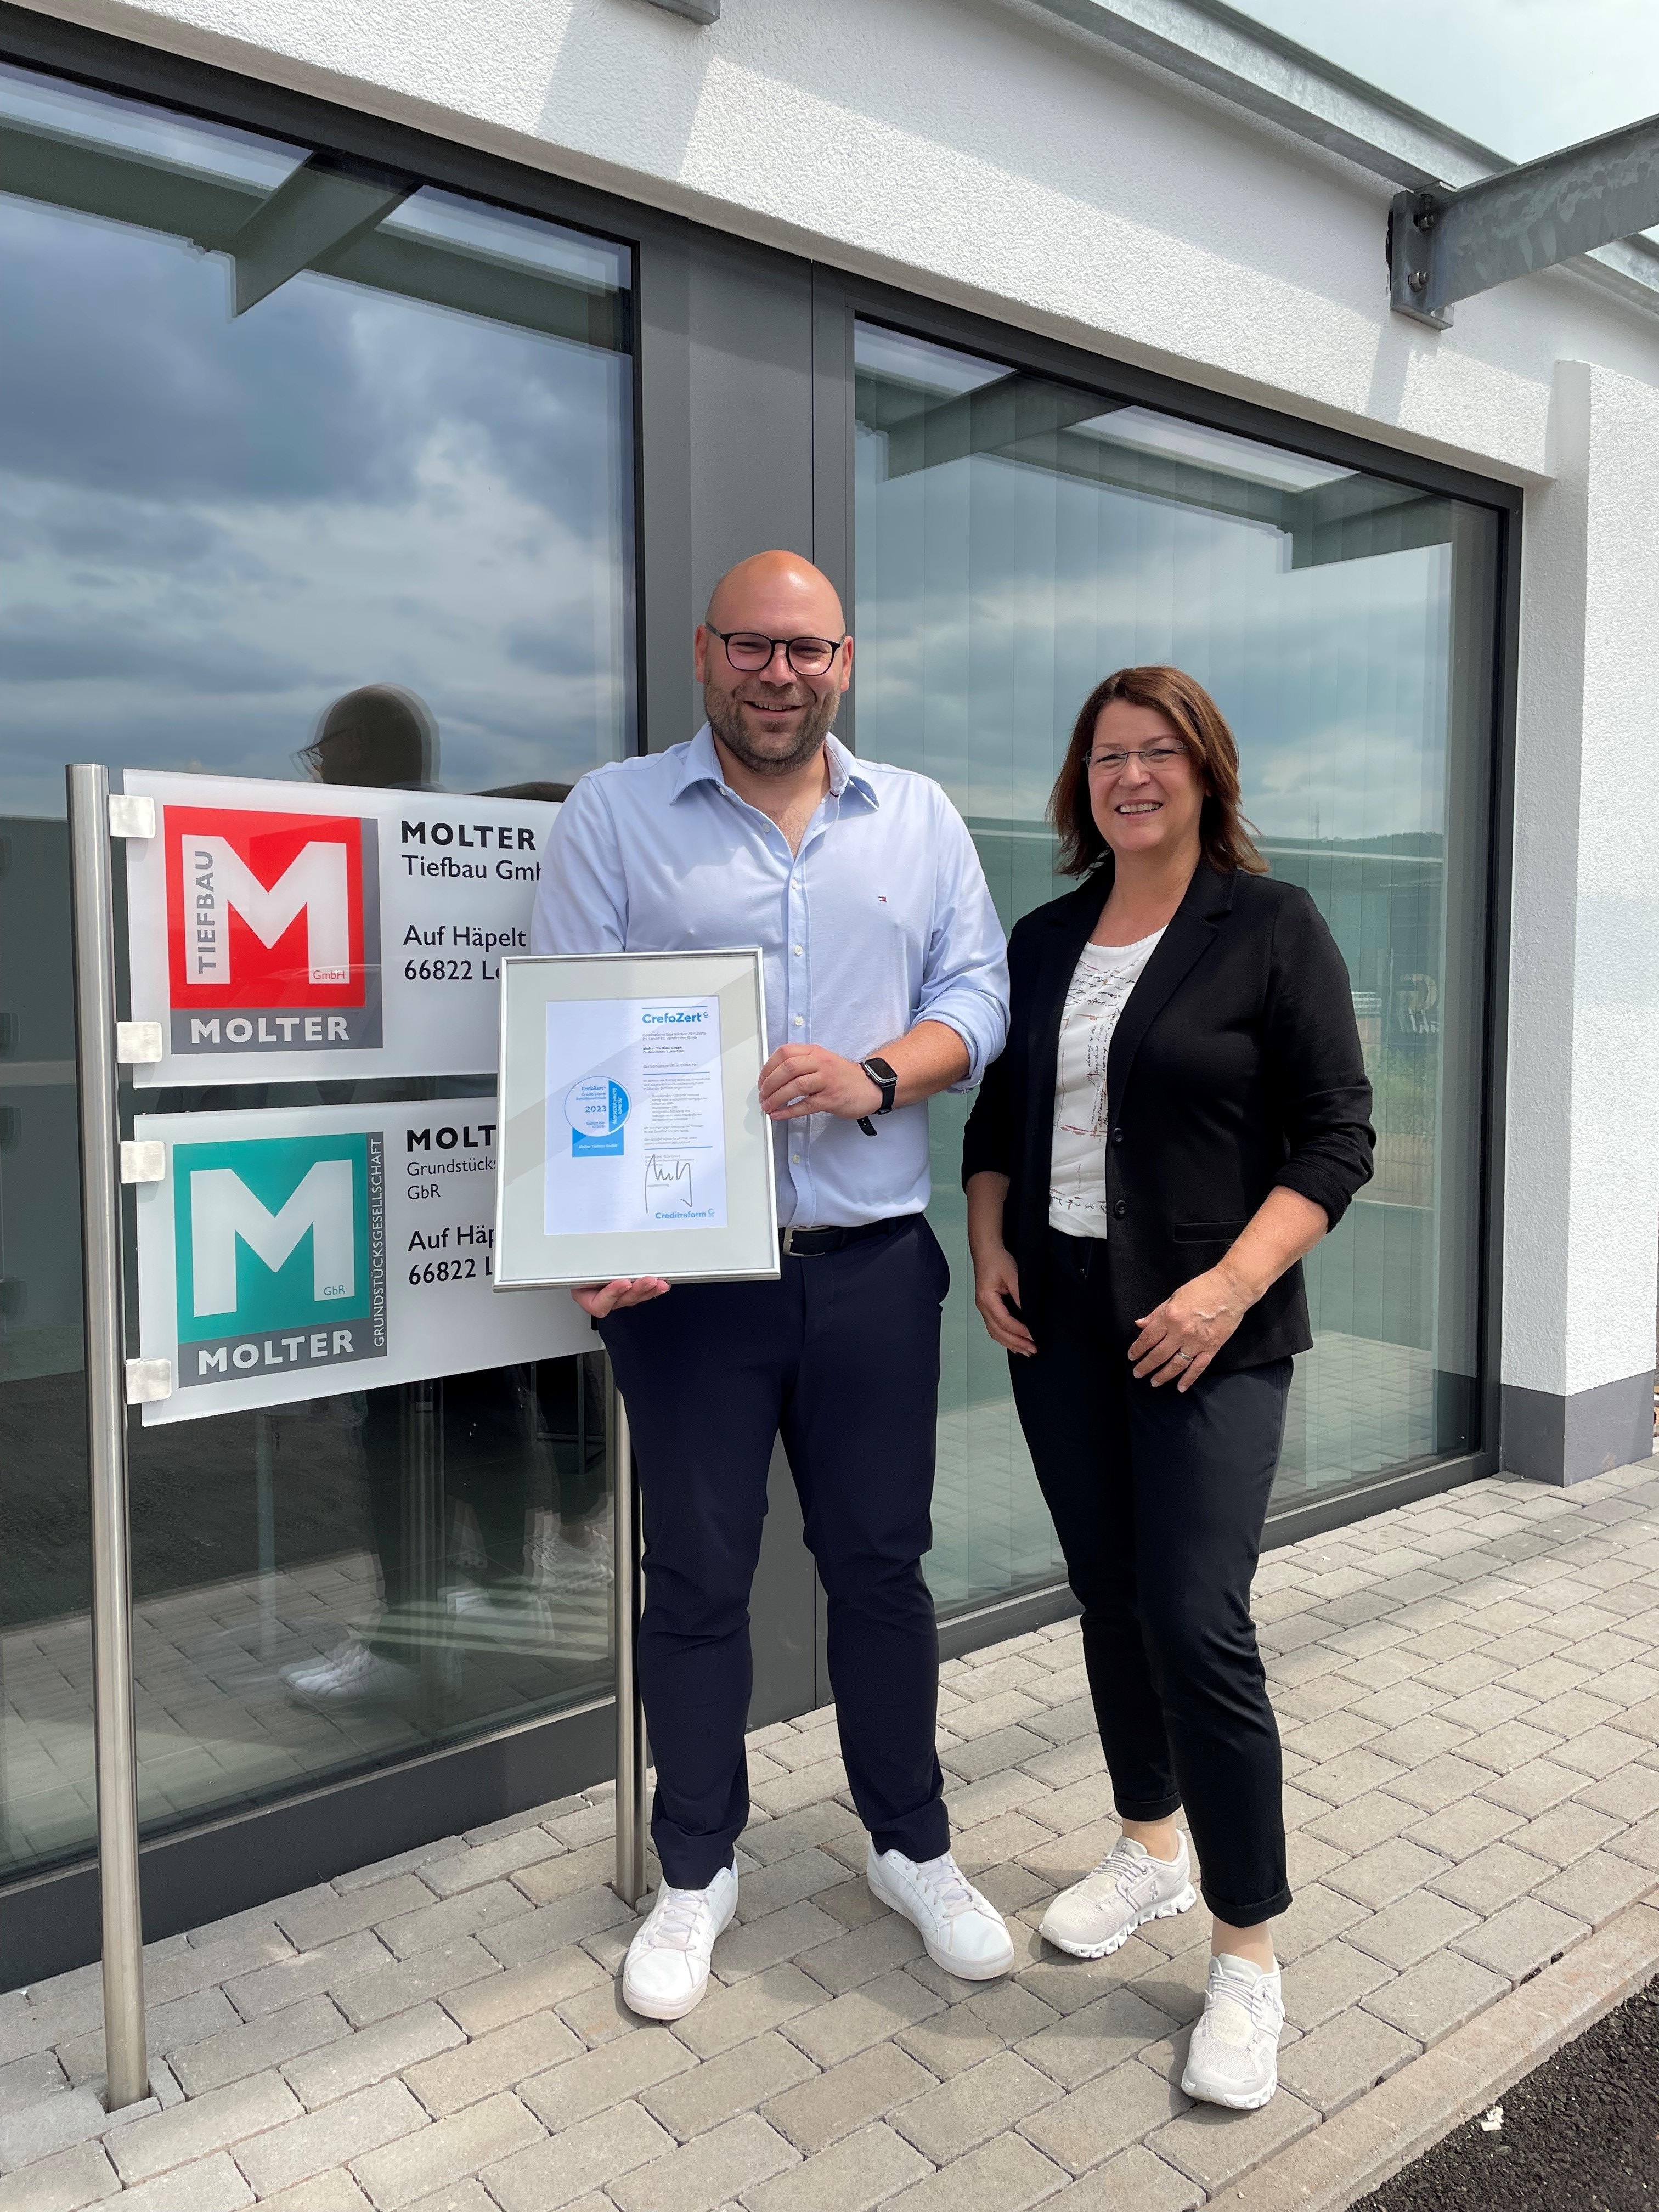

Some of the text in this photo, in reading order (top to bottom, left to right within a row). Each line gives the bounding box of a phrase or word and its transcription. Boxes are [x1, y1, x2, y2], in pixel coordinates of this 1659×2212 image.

[402, 821, 536, 850] MOLTER
[402, 854, 487, 878] Tiefbau
[182, 834, 350, 984] M
[195, 851, 216, 974] TIEFBAU
[403, 925, 527, 952] Auf Häpelt
[313, 970, 345, 980] GmbH
[404, 960, 473, 980] 66822
[191, 1017, 349, 1044] MOLTER
[642, 1013, 702, 1023] CrefoZert
[408, 1184, 441, 1199] GbR
[656, 1211, 706, 1219] Creditreform
[190, 1159, 355, 1317] M
[370, 1139, 385, 1347] GRUNDSTÜCKSGESELLSCHAFT
[408, 1227, 449, 1251] Auf
[409, 1258, 476, 1285] 66822
[323, 1285, 346, 1296] GbR
[198, 1330, 354, 1375] MOLTER
